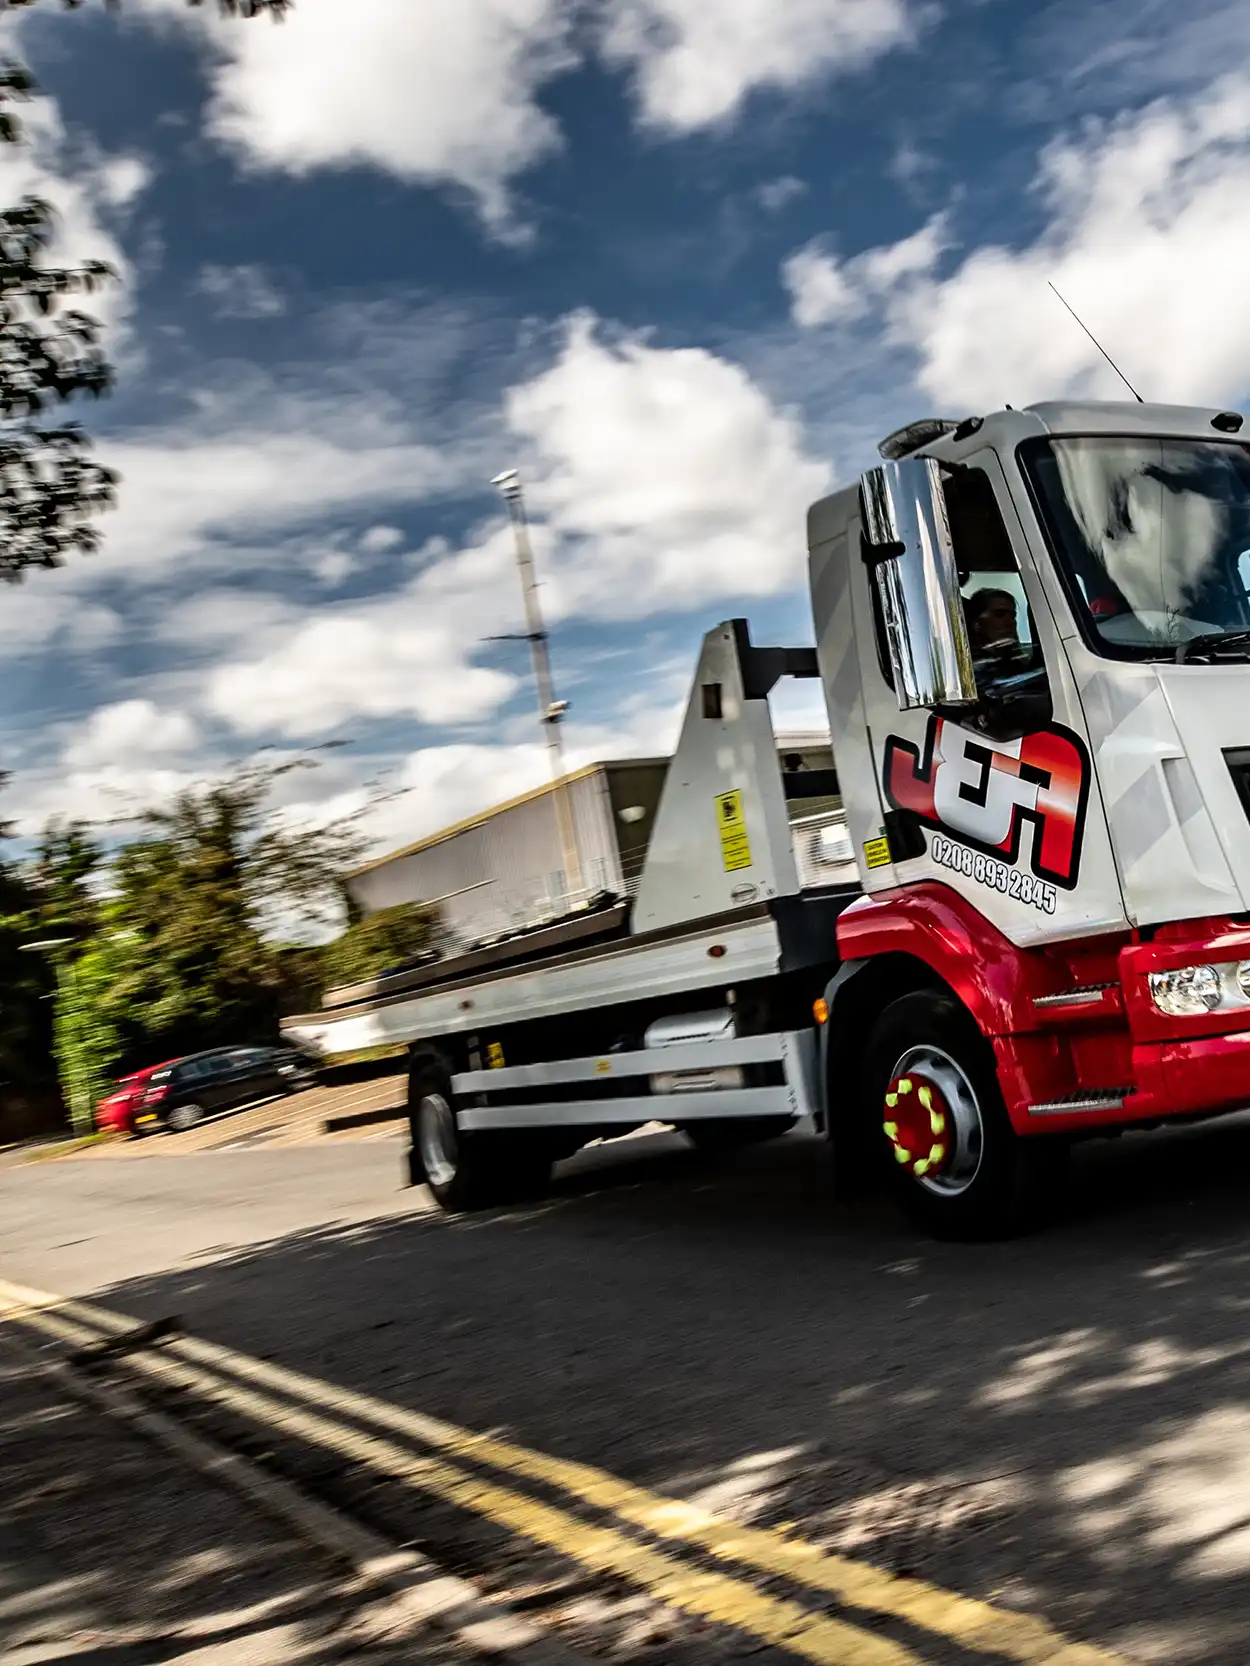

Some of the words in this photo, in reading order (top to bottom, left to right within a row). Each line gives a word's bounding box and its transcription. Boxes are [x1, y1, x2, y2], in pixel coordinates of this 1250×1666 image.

[931, 835, 973, 877] 0208
[973, 854, 1008, 893] 893
[1008, 869, 1057, 915] 2845
